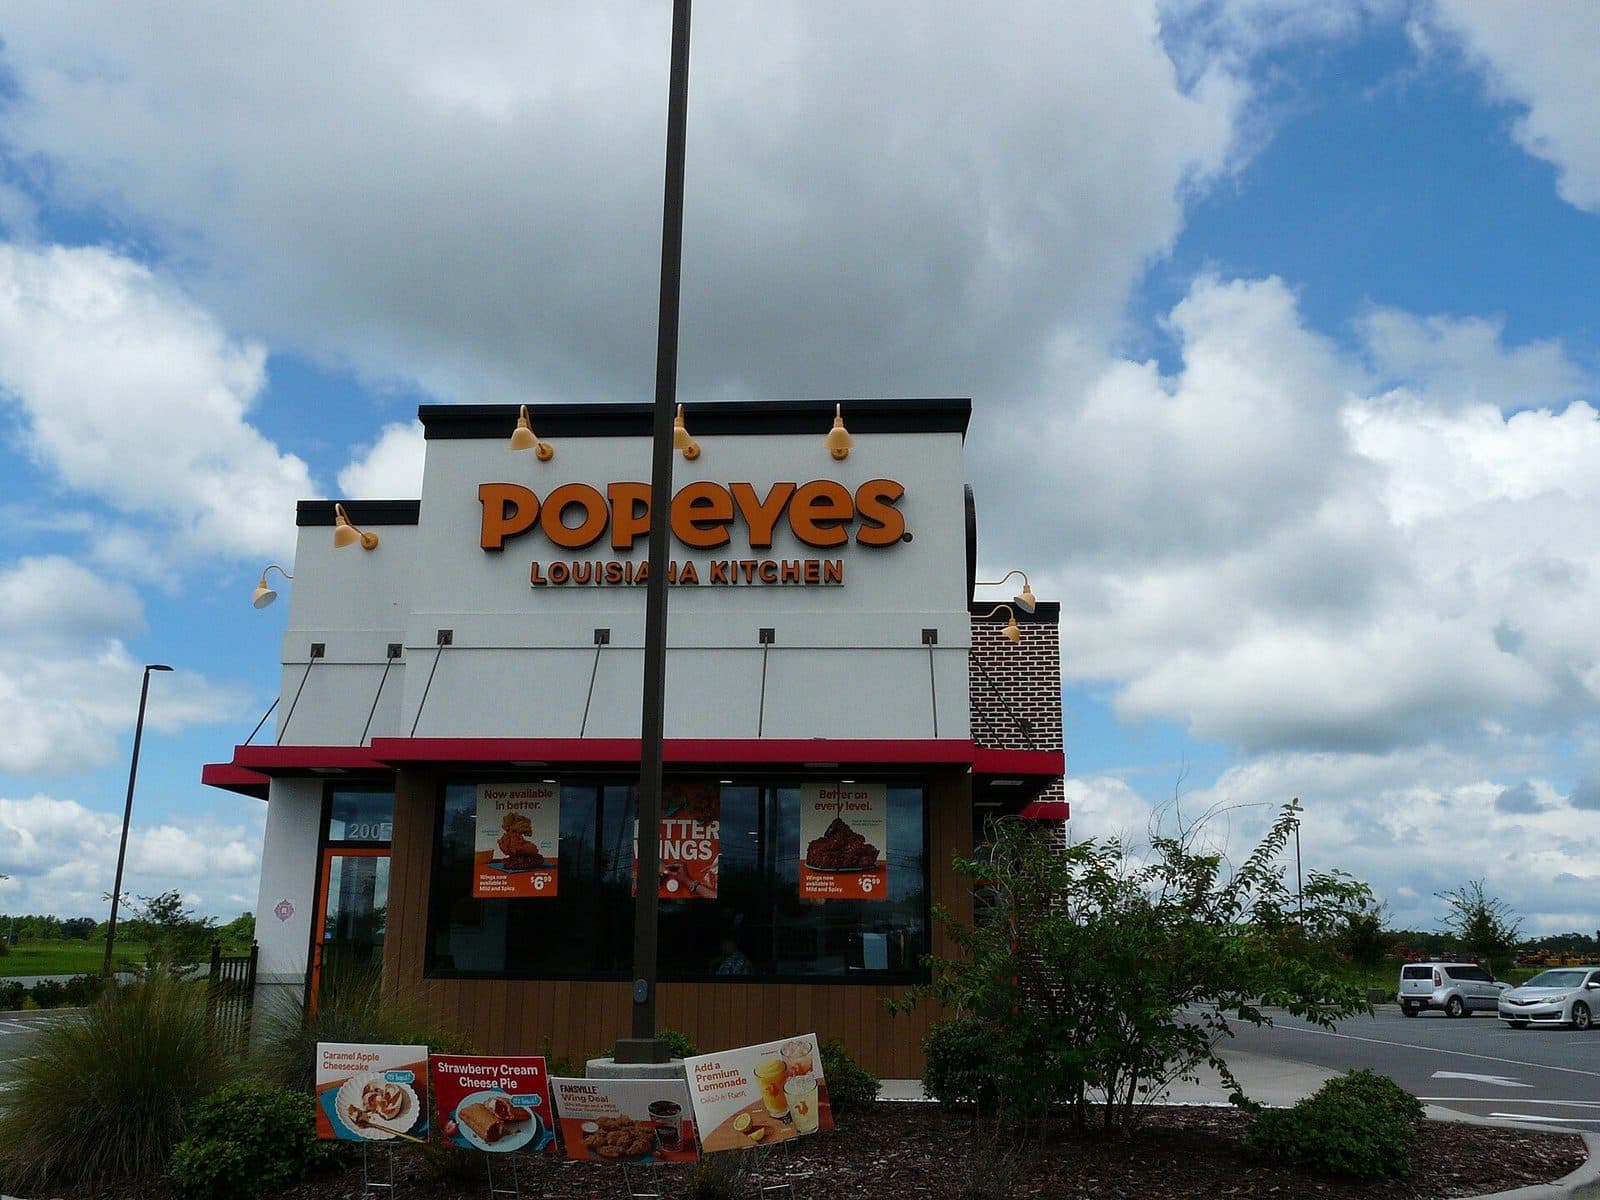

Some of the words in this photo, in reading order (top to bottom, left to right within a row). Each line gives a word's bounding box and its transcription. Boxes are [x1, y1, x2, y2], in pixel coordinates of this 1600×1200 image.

[710, 560, 843, 584] KITCHEN
[484, 789, 506, 799] Now
[509, 788, 553, 799] available
[820, 790, 852, 799] Better
[507, 801, 541, 810] better.
[815, 803, 843, 812] every
[846, 802, 872, 811] level.
[633, 819, 720, 839] TTER
[633, 840, 713, 860] INGS
[323, 1051, 356, 1060] Caramel
[356, 1052, 380, 1063] Apple
[323, 1061, 369, 1071] Cheesecake
[438, 1062, 498, 1077] Strawberry
[500, 1064, 538, 1076] Cream
[694, 1063, 713, 1073] Add
[696, 1069, 739, 1083] Premium
[459, 1077, 498, 1088] Cheese
[500, 1078, 518, 1089] Pie
[697, 1078, 747, 1092] Lemonade
[560, 1085, 597, 1094] FANSVILLE
[562, 1094, 587, 1103] Wing
[588, 1095, 609, 1103] Deal
